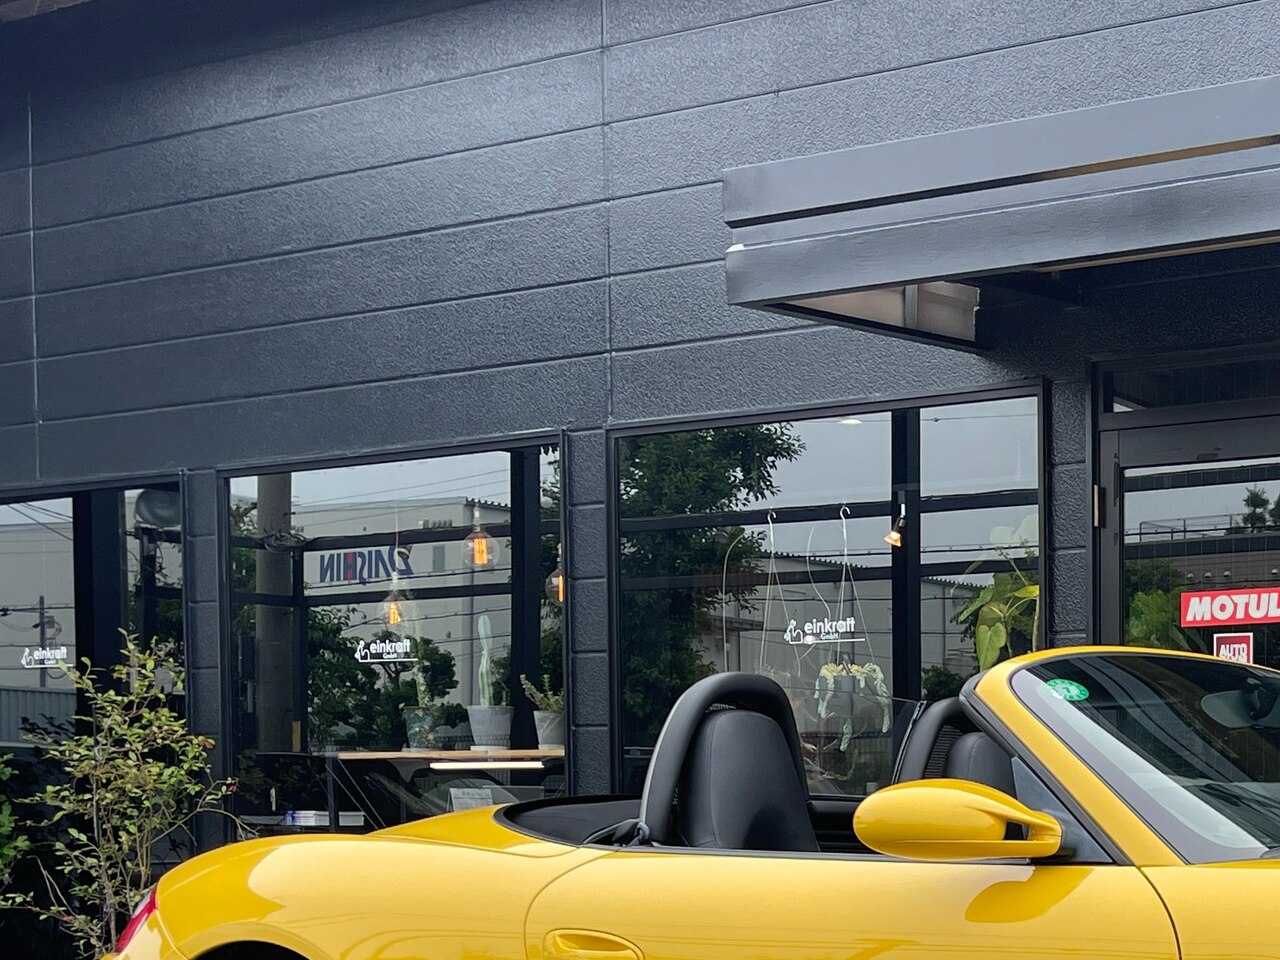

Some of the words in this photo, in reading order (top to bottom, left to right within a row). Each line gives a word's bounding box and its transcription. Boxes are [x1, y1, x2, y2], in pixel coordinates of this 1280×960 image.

[804, 617, 855, 633] einkraft
[33, 646, 67, 660] einkraft
[370, 639, 411, 653] einkraft
